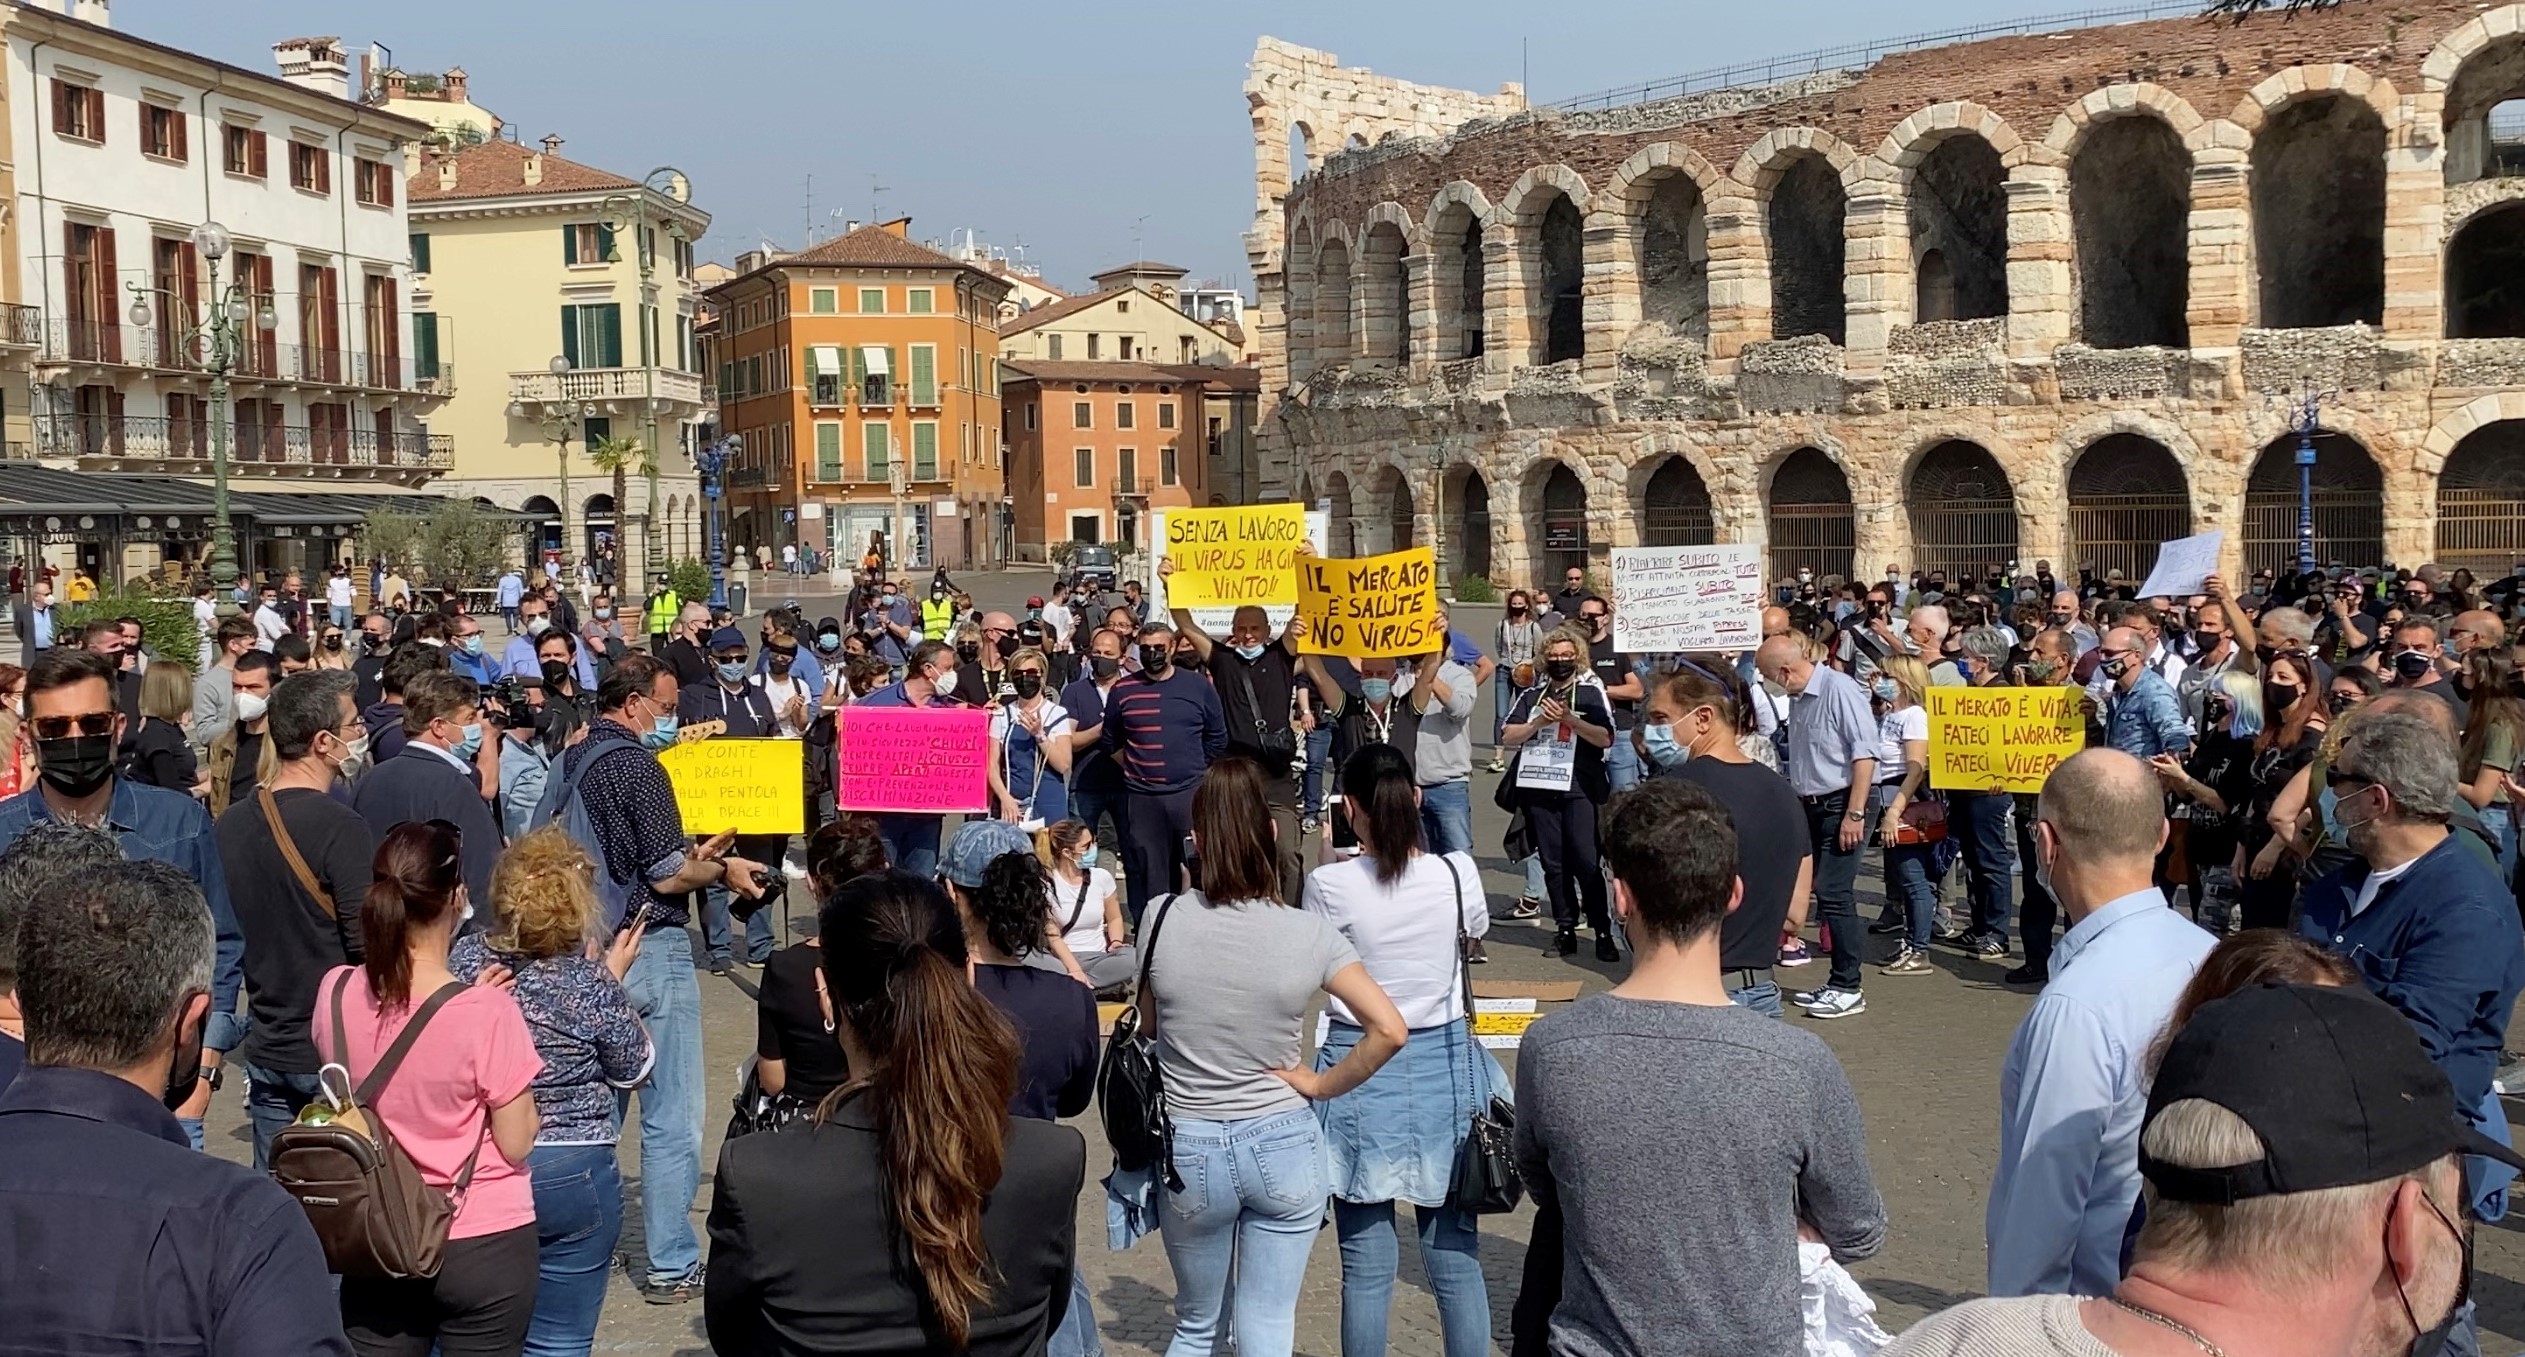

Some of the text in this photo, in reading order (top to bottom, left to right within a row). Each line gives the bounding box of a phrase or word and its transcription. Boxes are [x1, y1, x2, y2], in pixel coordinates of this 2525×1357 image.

[1169, 515, 1298, 544] SENZA LAVORO
[1175, 552, 1187, 572] IL
[1255, 547, 1273, 570] HA
[1679, 553, 1721, 566] SUBITO
[1728, 553, 1741, 563] LE
[1305, 560, 1429, 594] IL MERCATO
[1694, 579, 1736, 592] SUBITO
[1347, 590, 1426, 618] SALUTE
[1311, 616, 1344, 649] NO
[1932, 695, 1947, 716] IL
[1955, 695, 2012, 718] MERCATO
[2002, 723, 2072, 746] LAVORARE
[674, 745, 759, 760] DA CONTE
[694, 763, 752, 779] DRAGHI
[934, 766, 976, 779] QUESTA
[719, 785, 777, 799] PENTOLA
